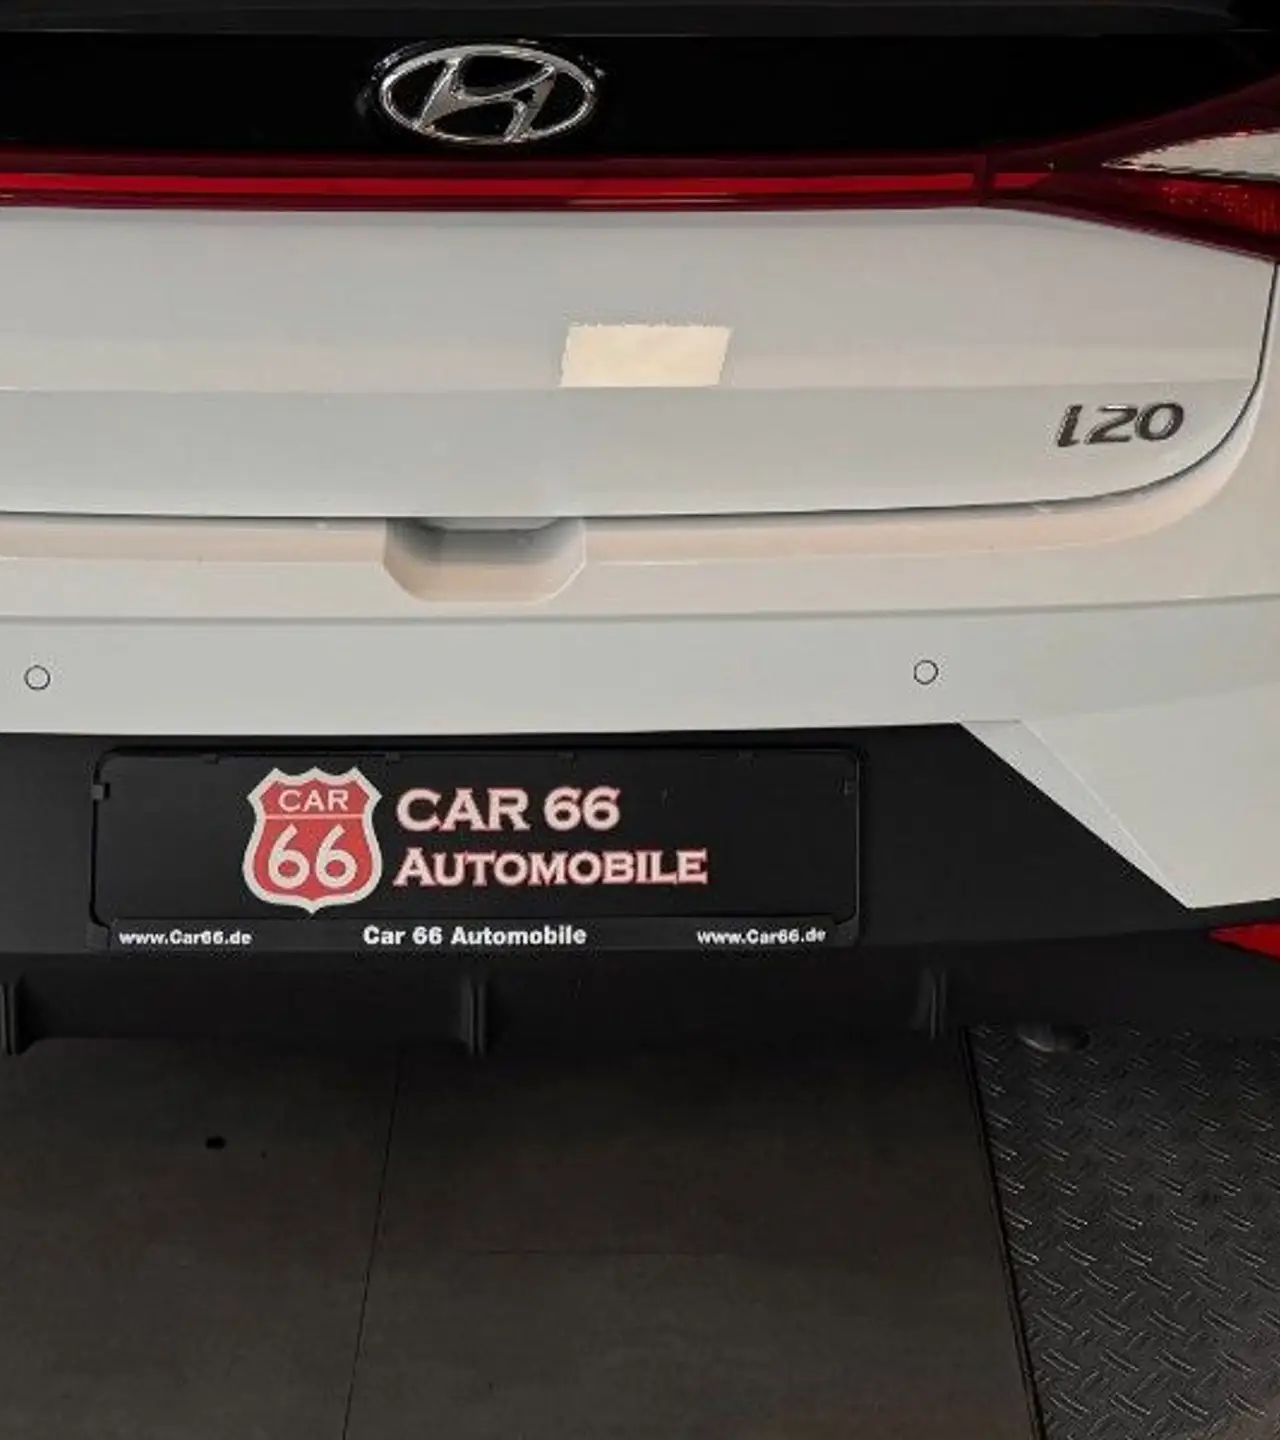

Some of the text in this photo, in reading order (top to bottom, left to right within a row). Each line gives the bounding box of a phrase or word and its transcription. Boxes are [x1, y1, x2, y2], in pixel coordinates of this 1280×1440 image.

[278, 789, 349, 813] CAR
[397, 785, 621, 832] CAR 66
[268, 823, 358, 890] 66
[392, 846, 708, 887] AUTOMOBILE
[119, 928, 253, 945] www.Car66.de
[363, 924, 588, 945] Car 66 Automobile
[696, 927, 827, 945] www.Car66.de
